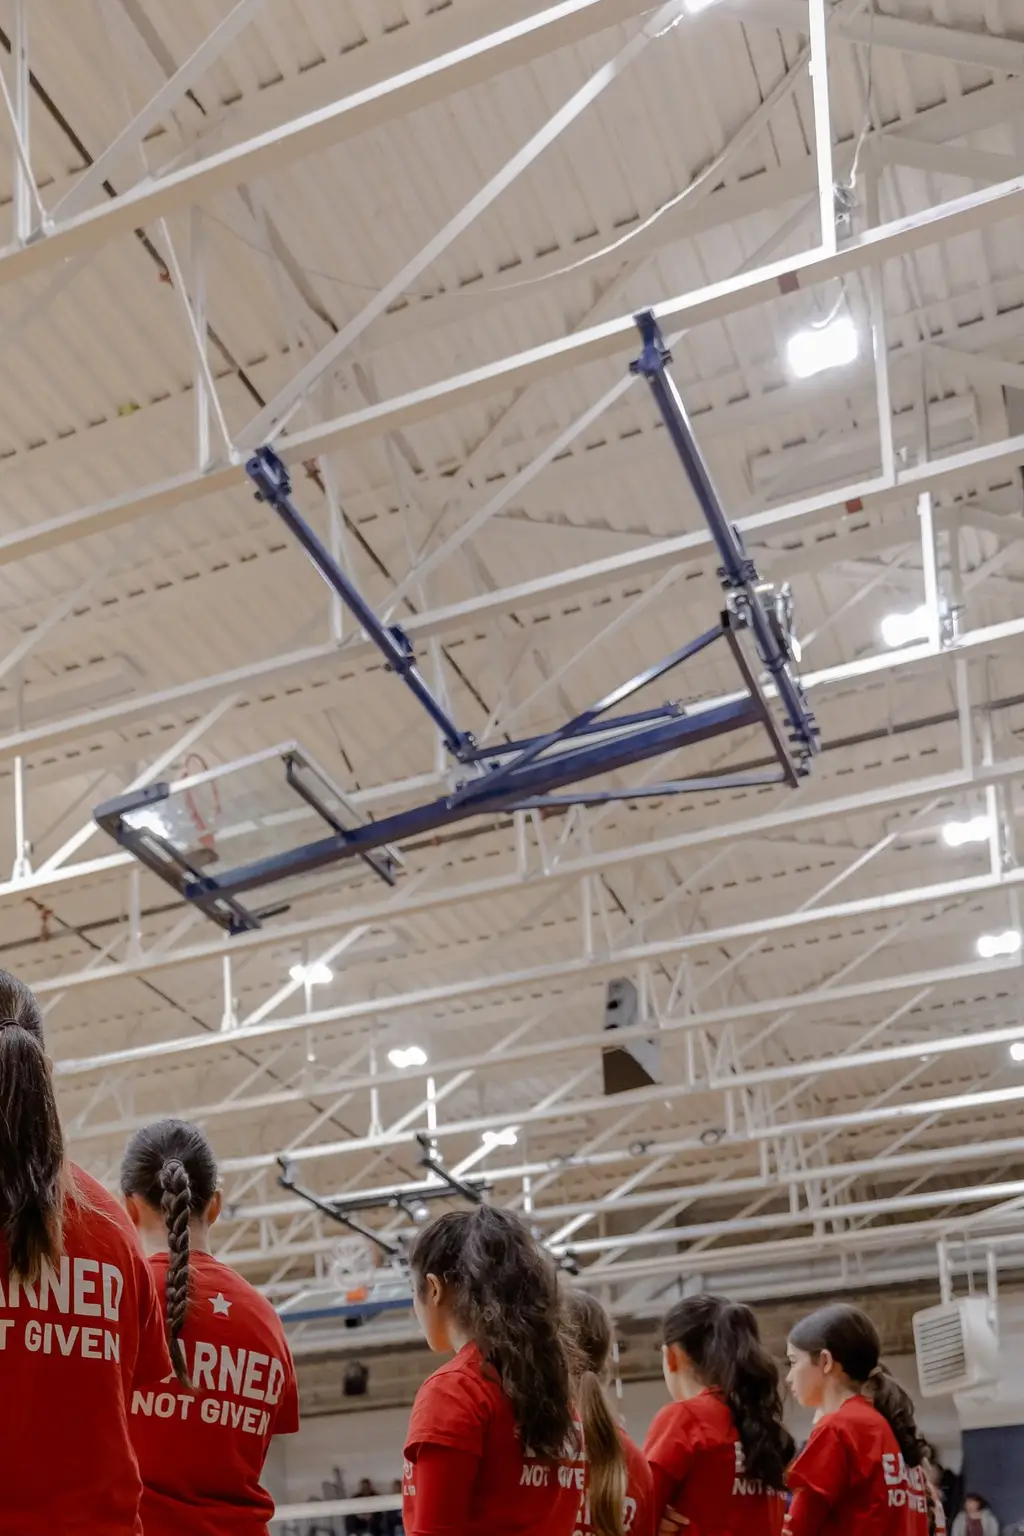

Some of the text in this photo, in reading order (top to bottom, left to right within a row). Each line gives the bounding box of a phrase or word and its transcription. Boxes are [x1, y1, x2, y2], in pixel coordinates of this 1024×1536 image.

[24, 1319, 120, 1364] GIVEN
[160, 1338, 285, 1405] RNED
[131, 1390, 271, 1436] NOT GIVEN
